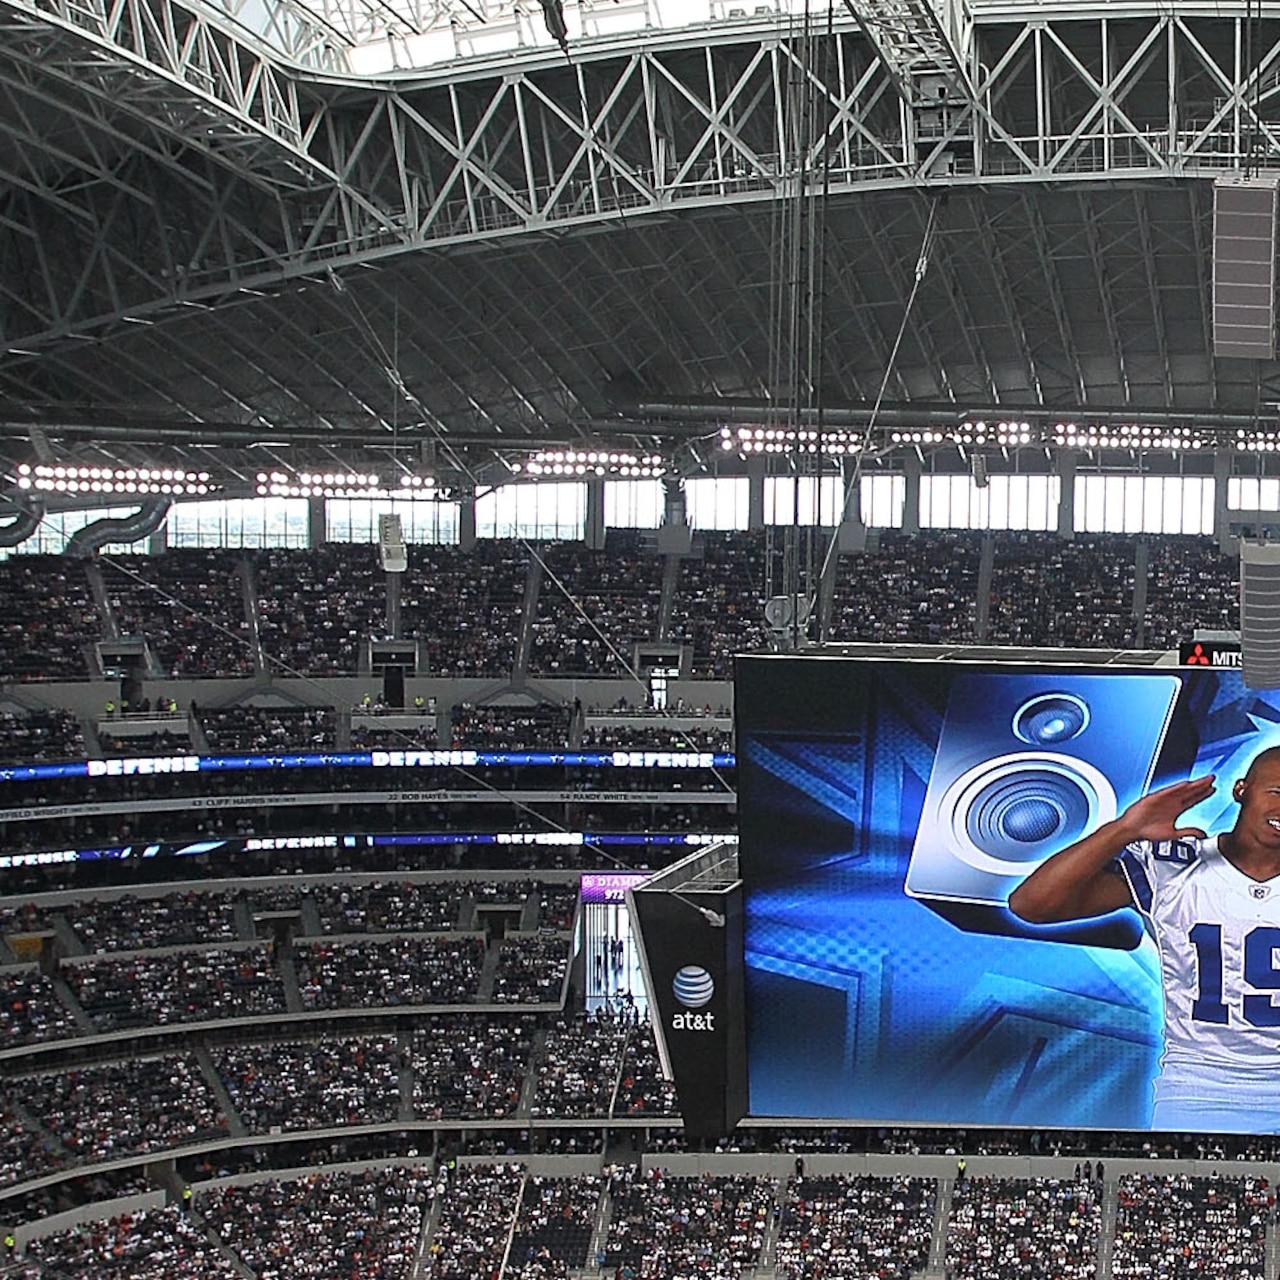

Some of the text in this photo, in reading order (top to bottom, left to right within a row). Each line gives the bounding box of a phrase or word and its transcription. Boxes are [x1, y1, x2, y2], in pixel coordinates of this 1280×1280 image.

[88, 756, 199, 776] DEFENSE
[371, 751, 477, 767] DEFENSE
[613, 752, 714, 767] DEFENSE
[401, 793, 420, 801] BOB
[421, 792, 449, 801] HAYES
[602, 793, 628, 801] WHITE
[246, 836, 337, 851] DEFENSE
[604, 889, 625, 900] 972
[672, 1010, 715, 1032] at&t
